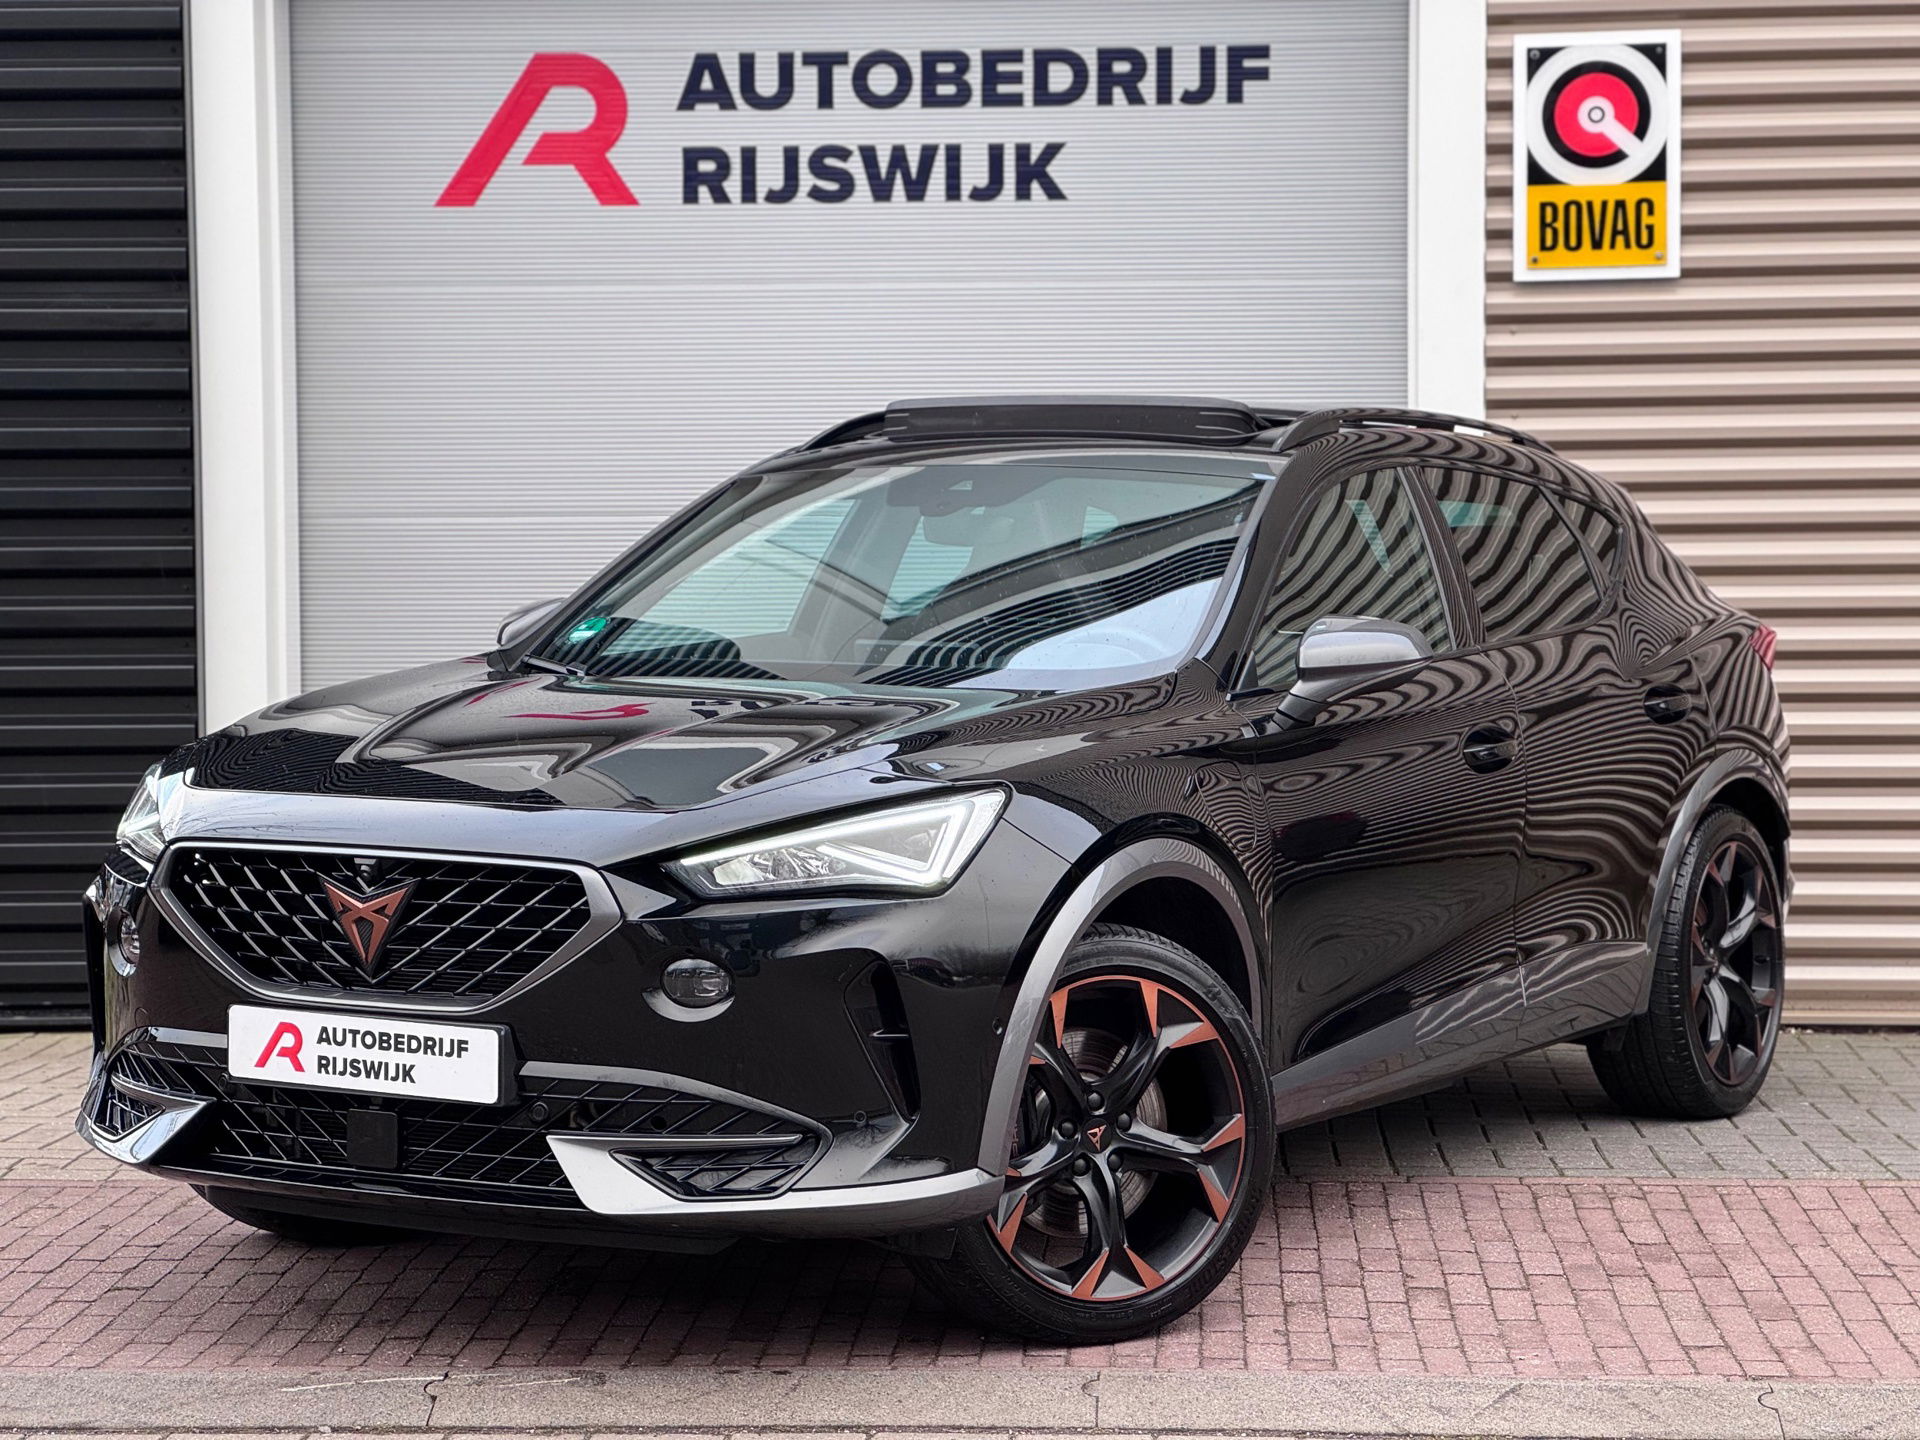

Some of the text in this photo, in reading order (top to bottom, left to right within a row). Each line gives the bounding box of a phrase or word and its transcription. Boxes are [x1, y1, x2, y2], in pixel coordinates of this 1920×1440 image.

[678, 45, 1271, 111] AUTOBEDRIJF
[682, 143, 1067, 205] RIJSWIJK
[1539, 198, 1655, 252] BOVAG
[316, 1025, 469, 1059] AUTOBEDRIJF
[316, 1055, 416, 1084] RIJSWIJK
